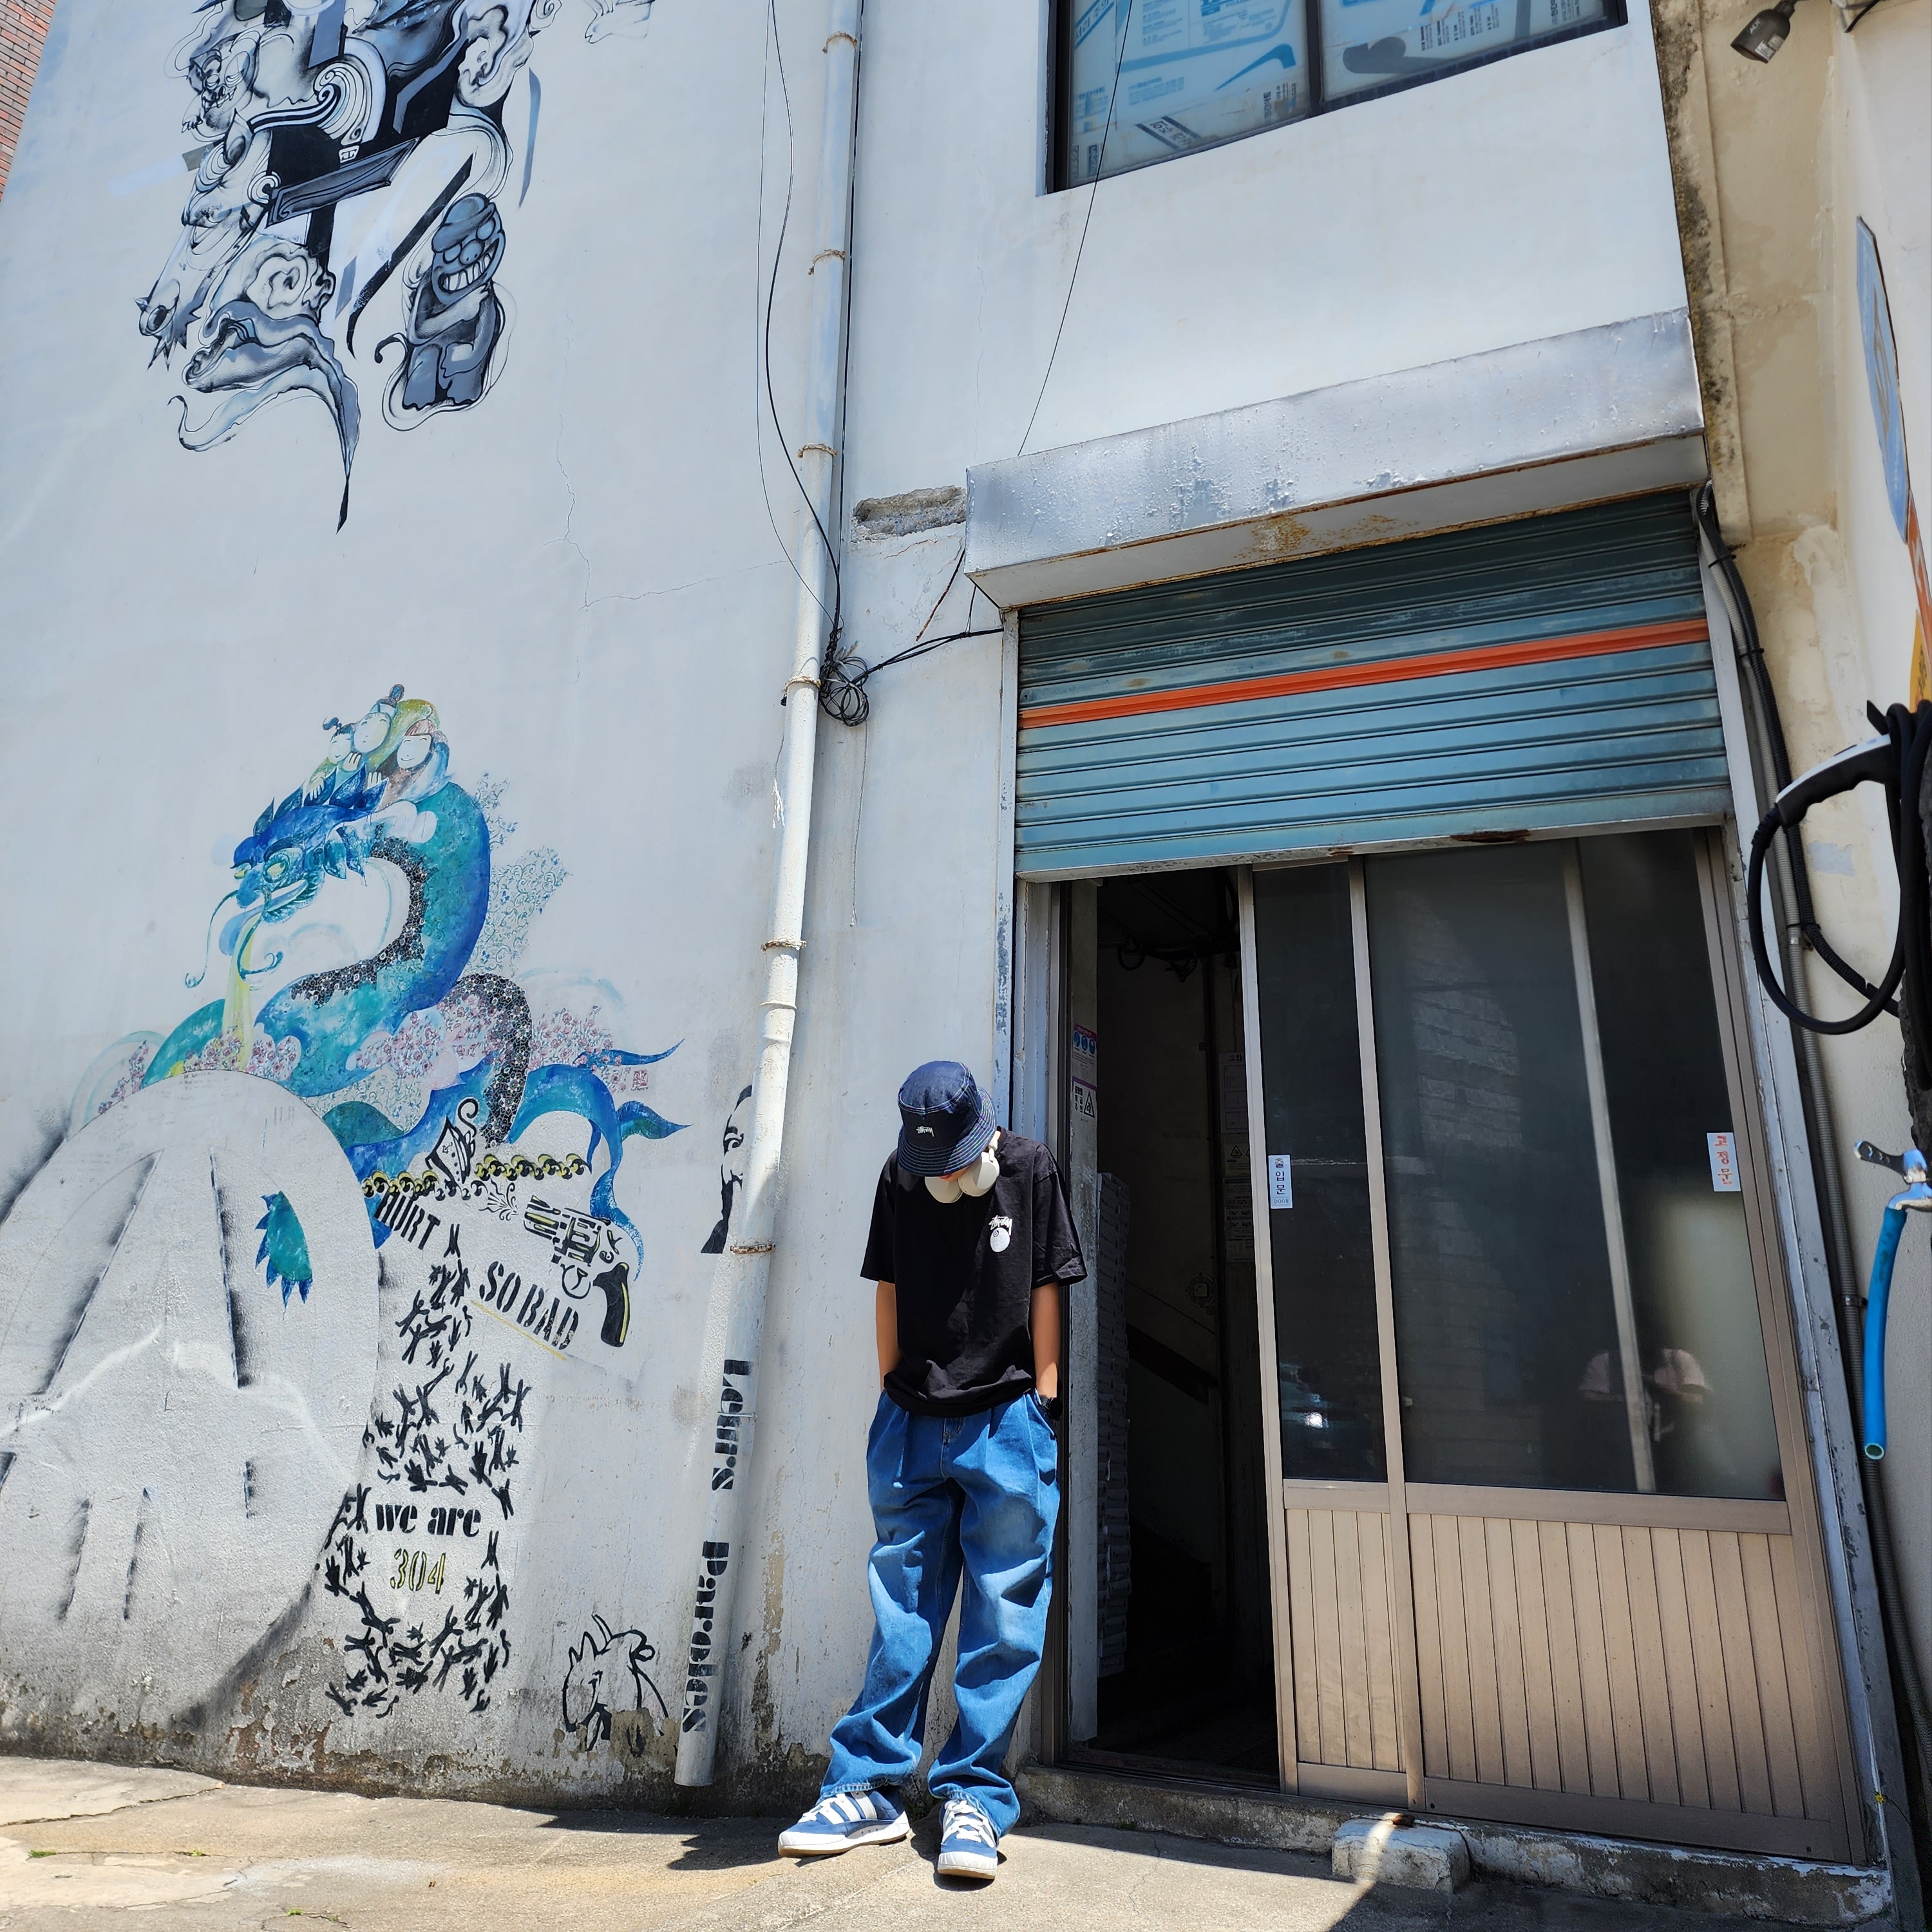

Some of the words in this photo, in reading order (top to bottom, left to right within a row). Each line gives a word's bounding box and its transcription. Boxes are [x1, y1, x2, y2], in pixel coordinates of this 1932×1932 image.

[1274, 1158, 1286, 1195] 출입문
[1715, 1135, 1734, 1185] 고정문
[479, 1260, 521, 1313] SO
[516, 1283, 579, 1350] BAD
[427, 1507, 482, 1538] are
[390, 1548, 446, 1595] 304
[682, 1540, 730, 1734] Paroles
